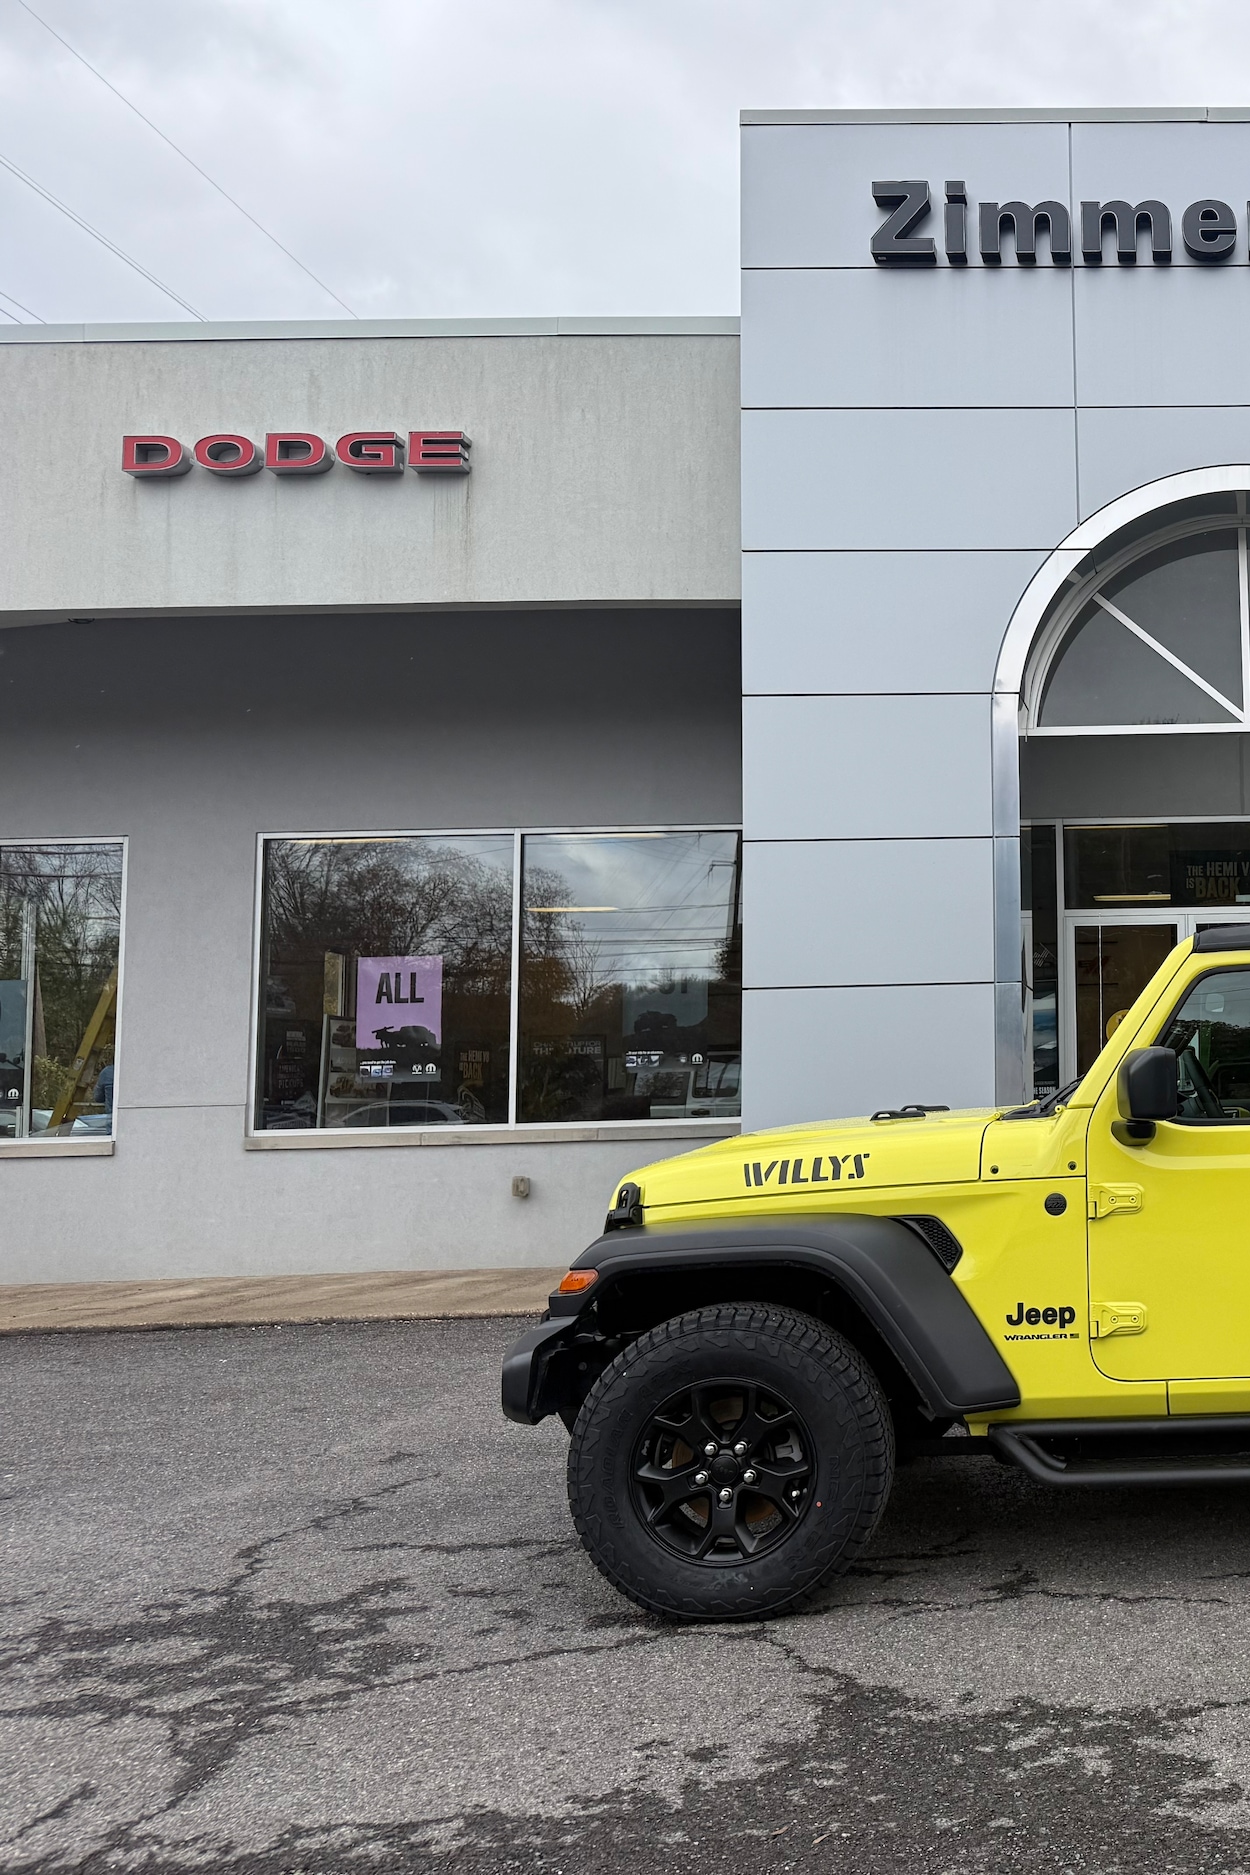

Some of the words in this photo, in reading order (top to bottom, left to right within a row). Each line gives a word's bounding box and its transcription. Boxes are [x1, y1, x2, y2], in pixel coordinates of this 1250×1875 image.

[122, 431, 472, 478] DODGE
[1187, 865, 1204, 876] THE
[1206, 861, 1238, 877] HEMI
[1195, 877, 1241, 898] BACK
[375, 972, 425, 1004] ALL
[743, 1152, 871, 1187] WILLYS
[1006, 1301, 1076, 1330] Jeep
[1004, 1332, 1069, 1342] WRANGLER
